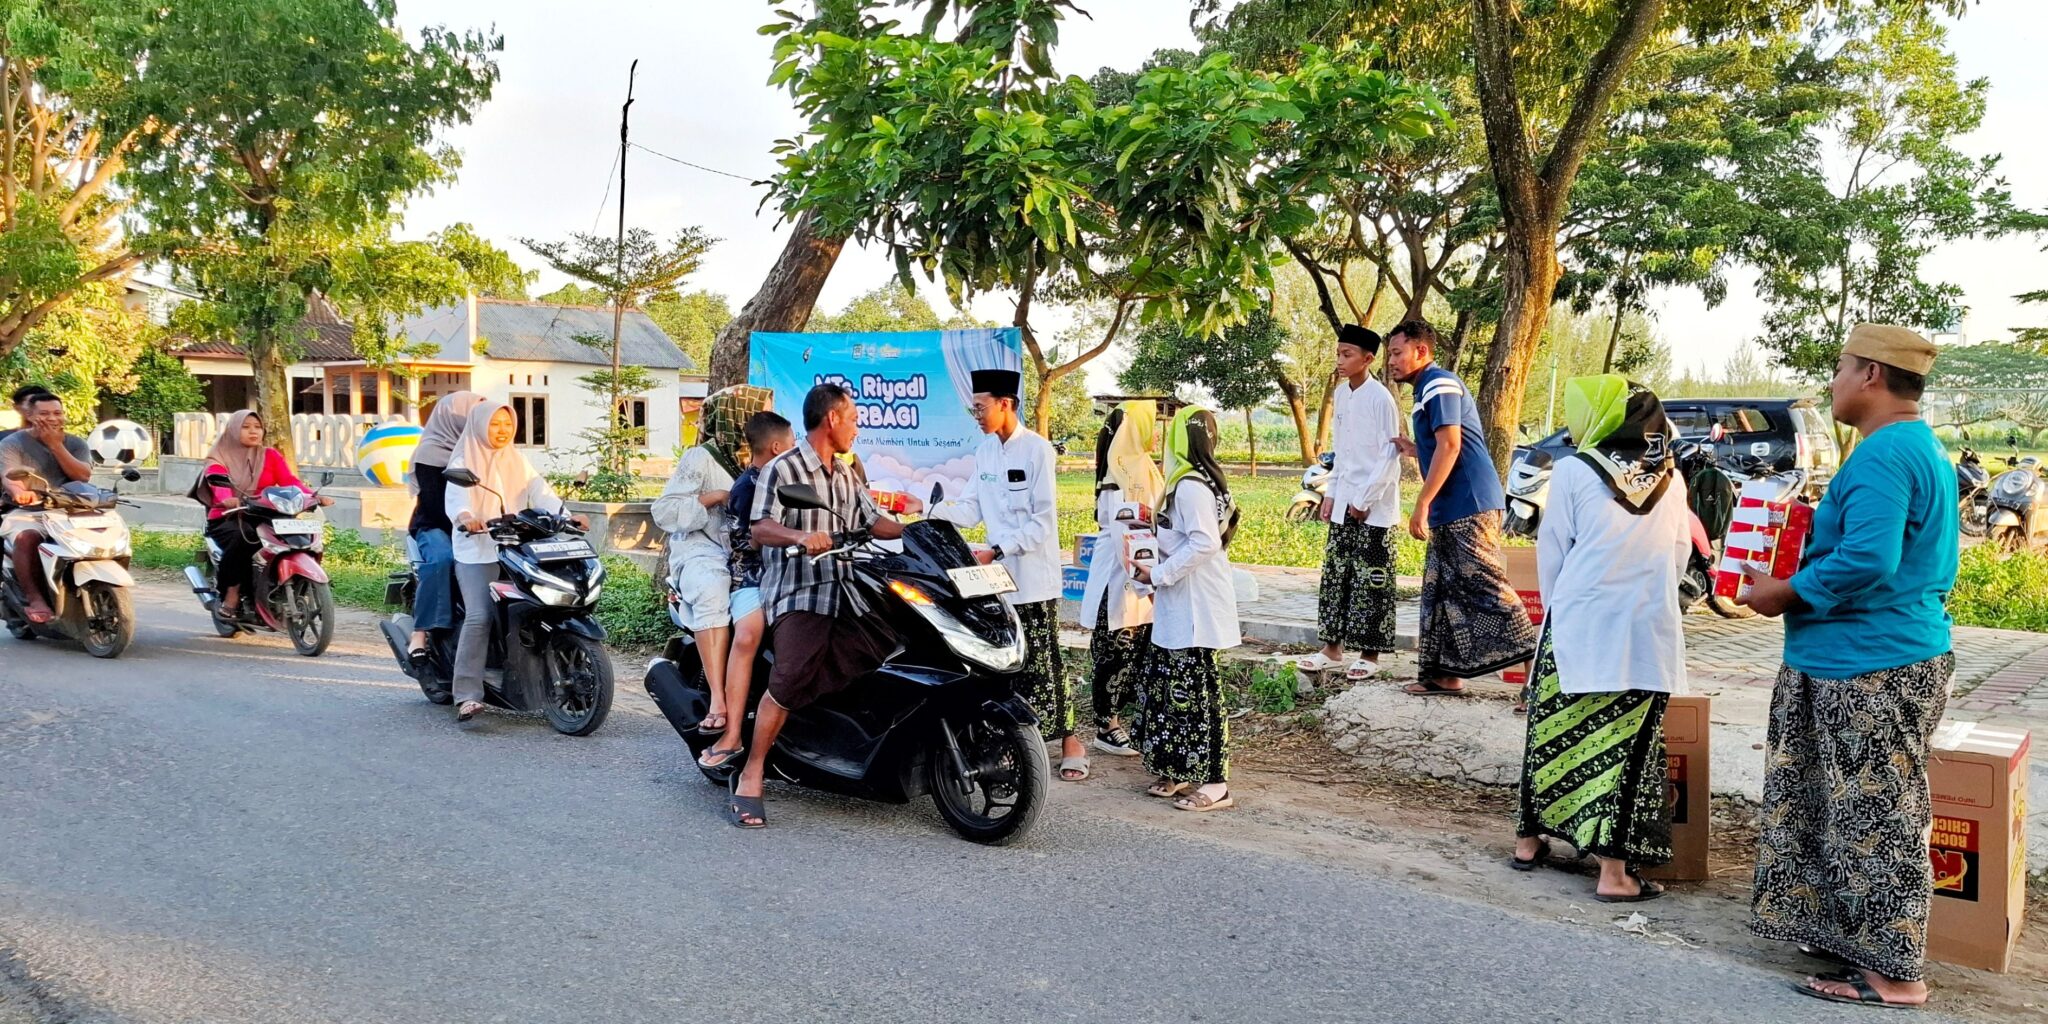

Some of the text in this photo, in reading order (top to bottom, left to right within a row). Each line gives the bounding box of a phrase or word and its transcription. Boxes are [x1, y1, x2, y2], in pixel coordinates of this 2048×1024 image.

[856, 404, 919, 428] RBAGI
[907, 437, 930, 448] Untuk
[951, 571, 960, 583] K
[965, 567, 990, 581] 2671
[1061, 576, 1087, 591] prim
[1931, 832, 1967, 848] ROCK
